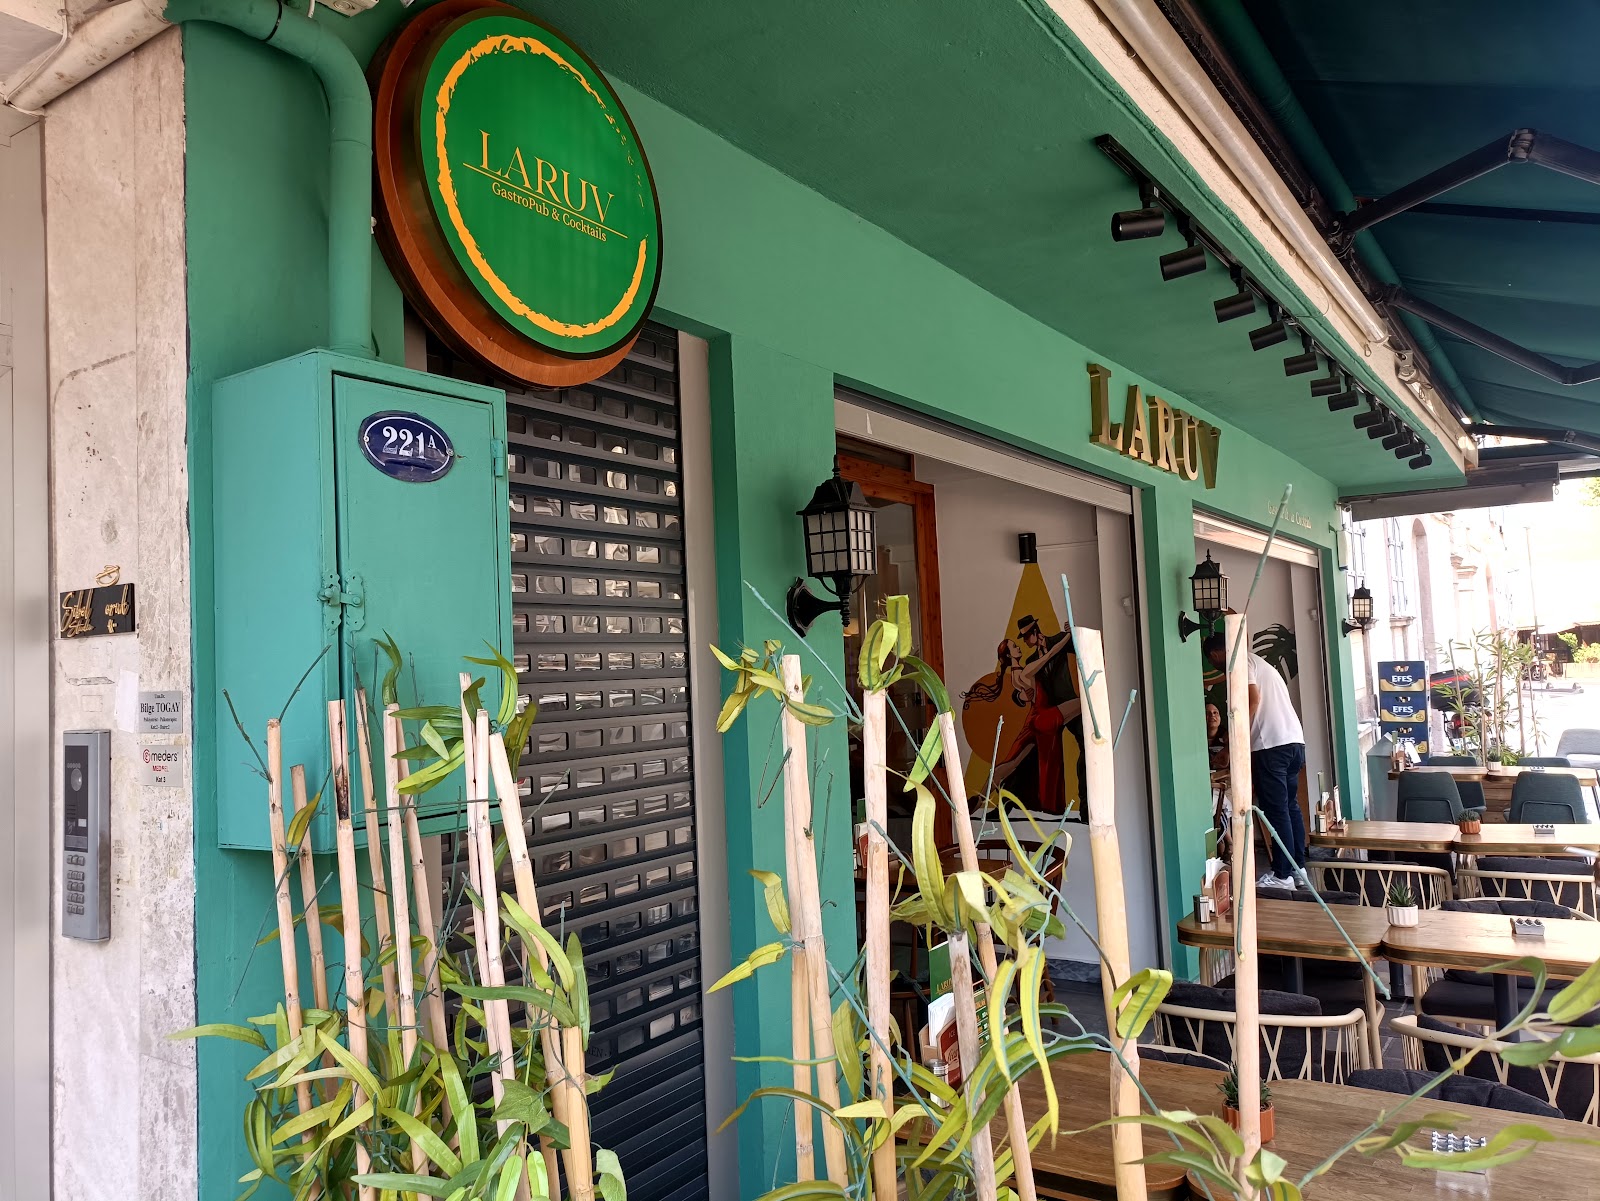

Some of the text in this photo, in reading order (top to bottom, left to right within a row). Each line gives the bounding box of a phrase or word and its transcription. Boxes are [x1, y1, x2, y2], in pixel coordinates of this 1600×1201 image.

[479, 129, 614, 223] LARUV
[491, 181, 607, 242] GastroPub & Cocktails
[1087, 363, 1221, 489] LARUV
[1391, 675, 1413, 683] EFES
[140, 701, 180, 715] Bilge TOGAY
[1392, 705, 1414, 713] EFES
[151, 749, 177, 762] meders
